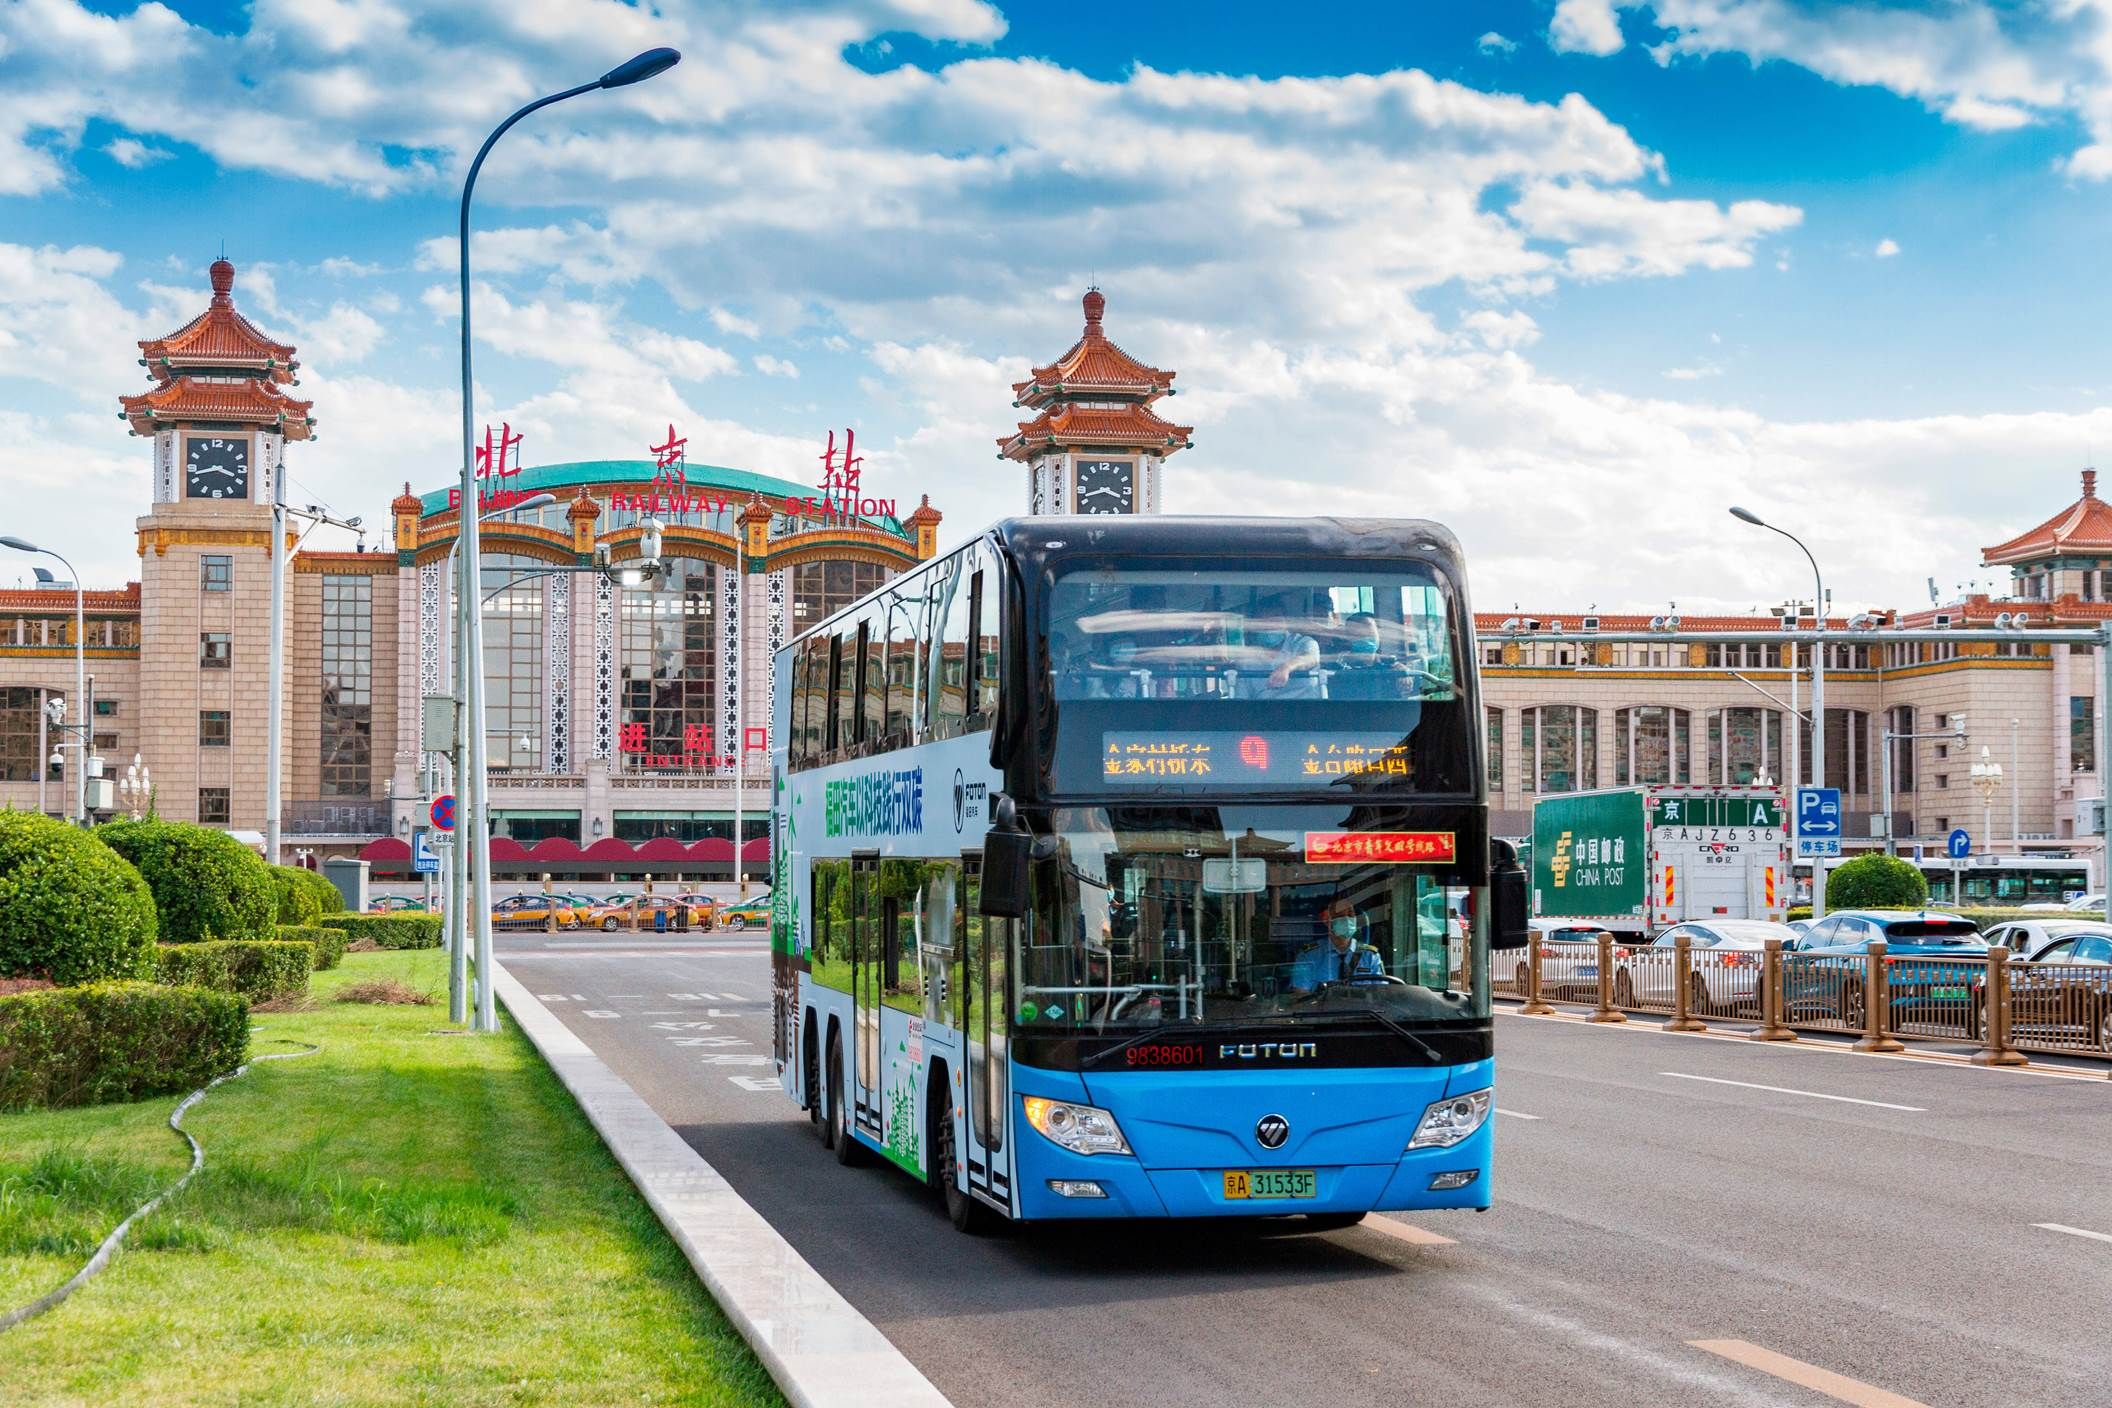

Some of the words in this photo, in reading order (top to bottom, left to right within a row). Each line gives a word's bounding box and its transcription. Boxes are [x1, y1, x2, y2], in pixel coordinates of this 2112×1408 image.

[211, 439, 224, 448] 12
[187, 464, 197, 472] 9
[238, 465, 248, 473] 3
[1099, 462, 1110, 471] 12
[212, 490, 222, 498] 6
[1077, 486, 1086, 494] 9
[1123, 487, 1132, 495] 3
[611, 492, 729, 513] RAILWAY
[785, 496, 896, 517] STATION
[618, 722, 767, 752] 进站口
[1802, 793, 1821, 815] P
[1664, 800, 1680, 820] 京
[1752, 803, 1769, 824] A
[1575, 836, 1625, 866] 中国邮政
[1801, 841, 1839, 853] 停车场
[1576, 868, 1601, 887] CHINA
[1604, 867, 1625, 886] POST
[1125, 1044, 1204, 1066] 9838601
